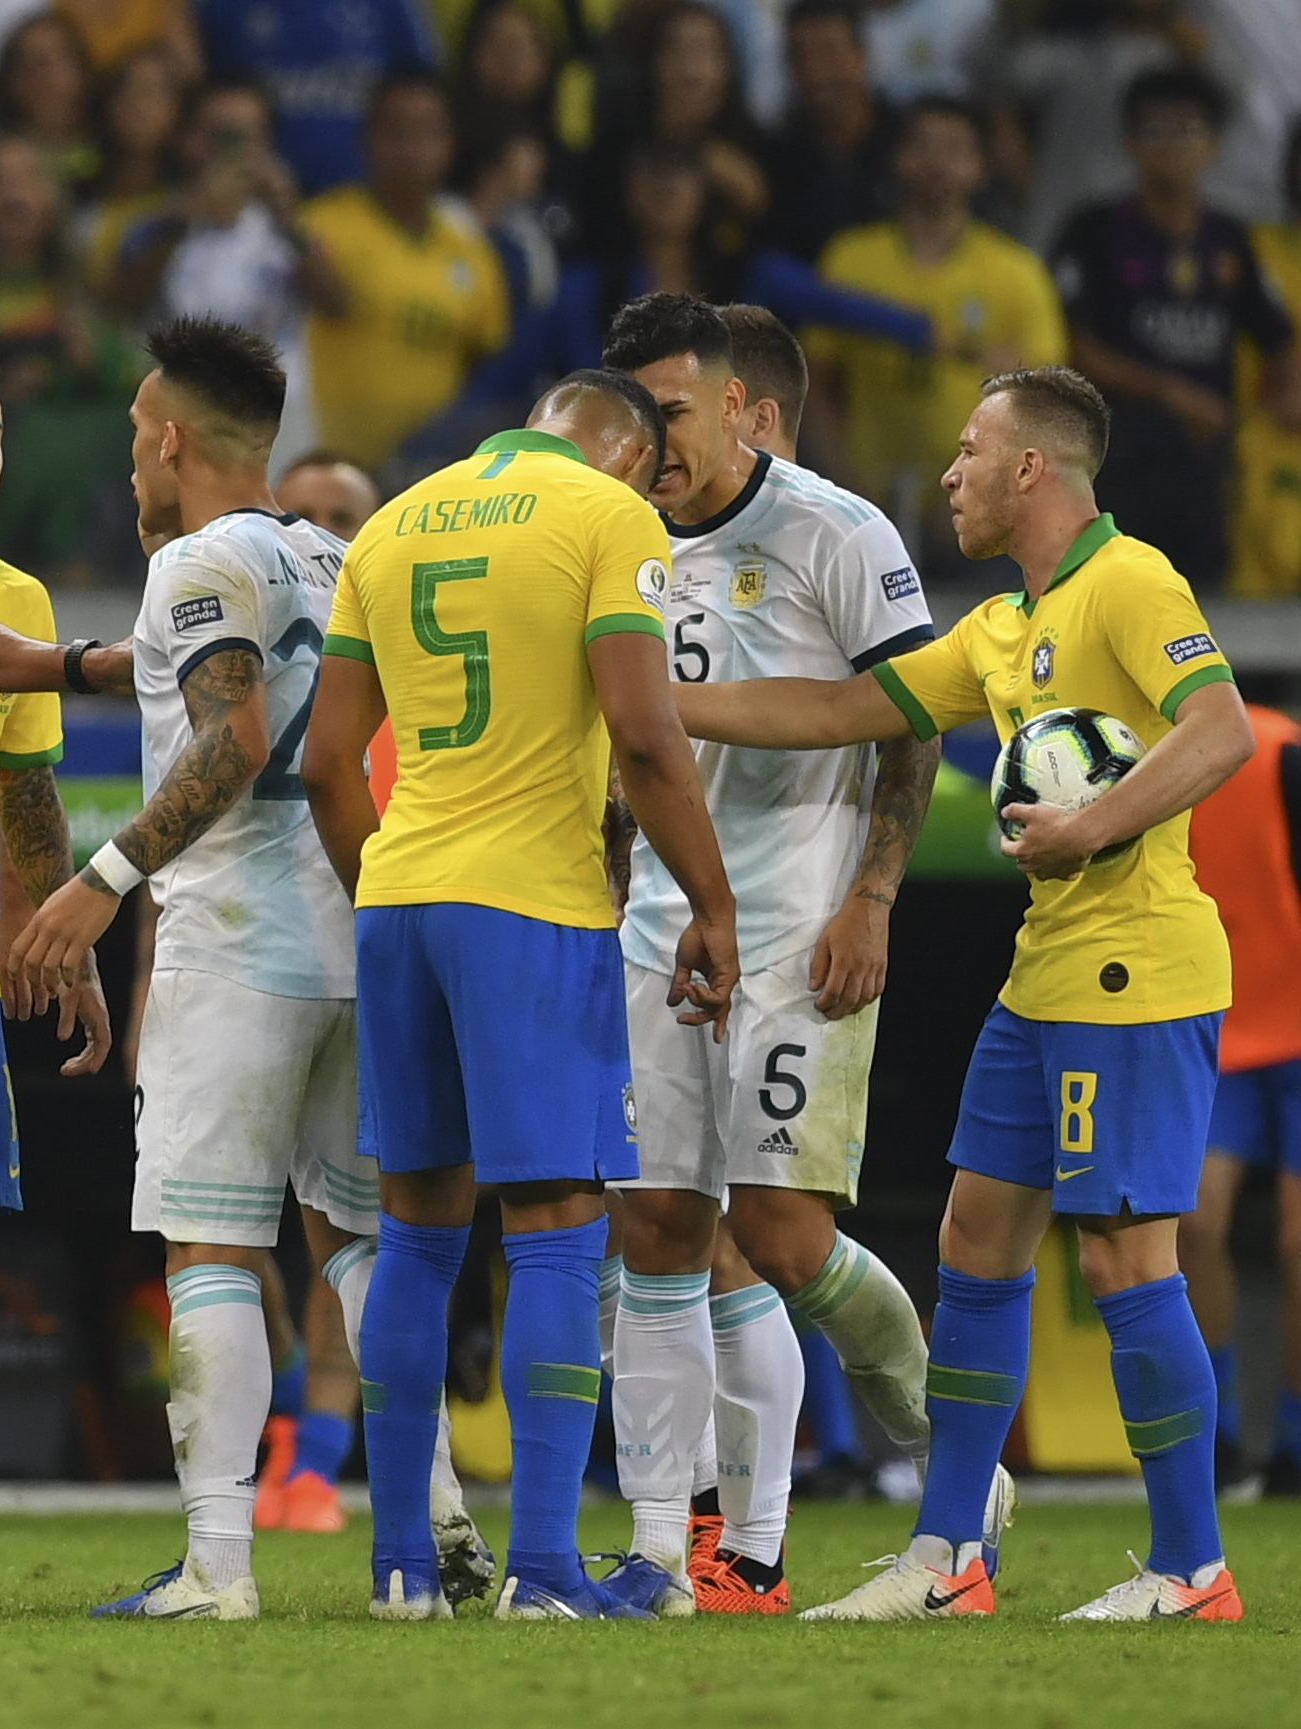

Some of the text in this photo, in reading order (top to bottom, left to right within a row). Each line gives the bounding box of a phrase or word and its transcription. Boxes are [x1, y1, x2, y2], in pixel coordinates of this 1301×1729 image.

[395, 493, 538, 537] CASEMIRO
[173, 600, 218, 618] Cree en
[176, 609, 217, 630] grande
[411, 556, 491, 751] 5
[673, 612, 711, 683] 5
[1166, 636, 1209, 654] Cree en
[1172, 643, 1212, 663] grande
[758, 1043, 806, 1121] 5
[1061, 1070, 1098, 1153] 8
[758, 1144, 800, 1156] adidas
